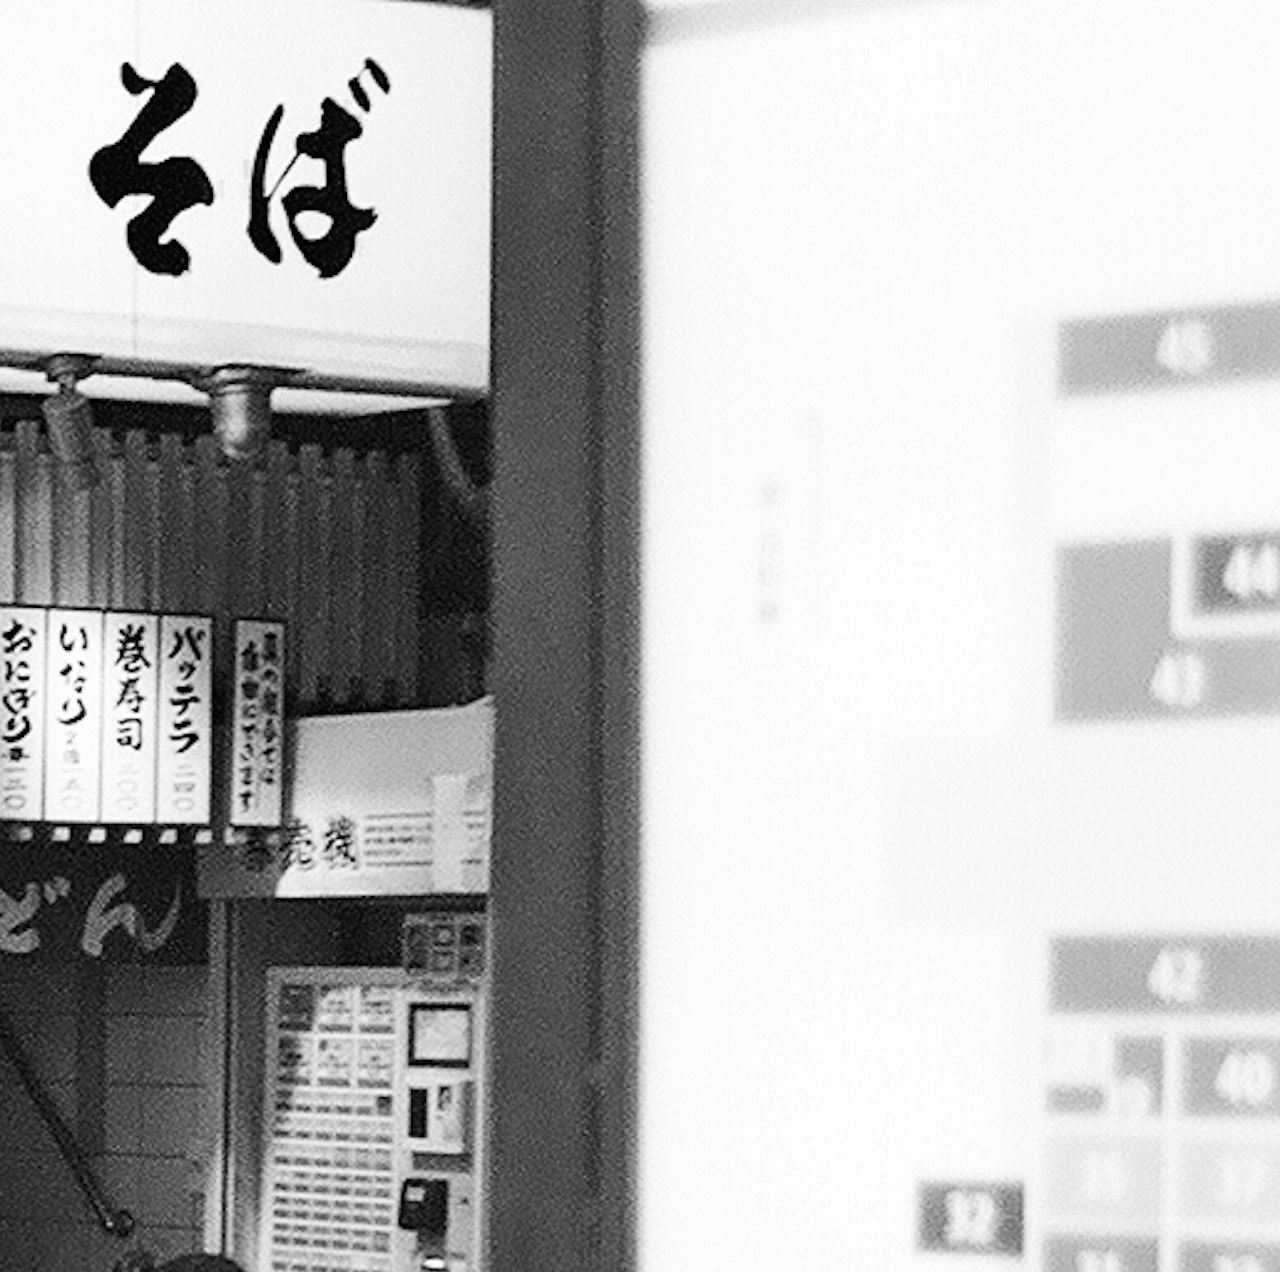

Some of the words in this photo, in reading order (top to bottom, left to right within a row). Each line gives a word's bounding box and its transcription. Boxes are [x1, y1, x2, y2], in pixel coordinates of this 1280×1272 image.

[89, 58, 390, 278] そば
[2, 618, 36, 744] おにぎり
[58, 624, 89, 725] いなり
[116, 624, 151, 751] 巻寿司
[169, 626, 206, 754] バッテラ
